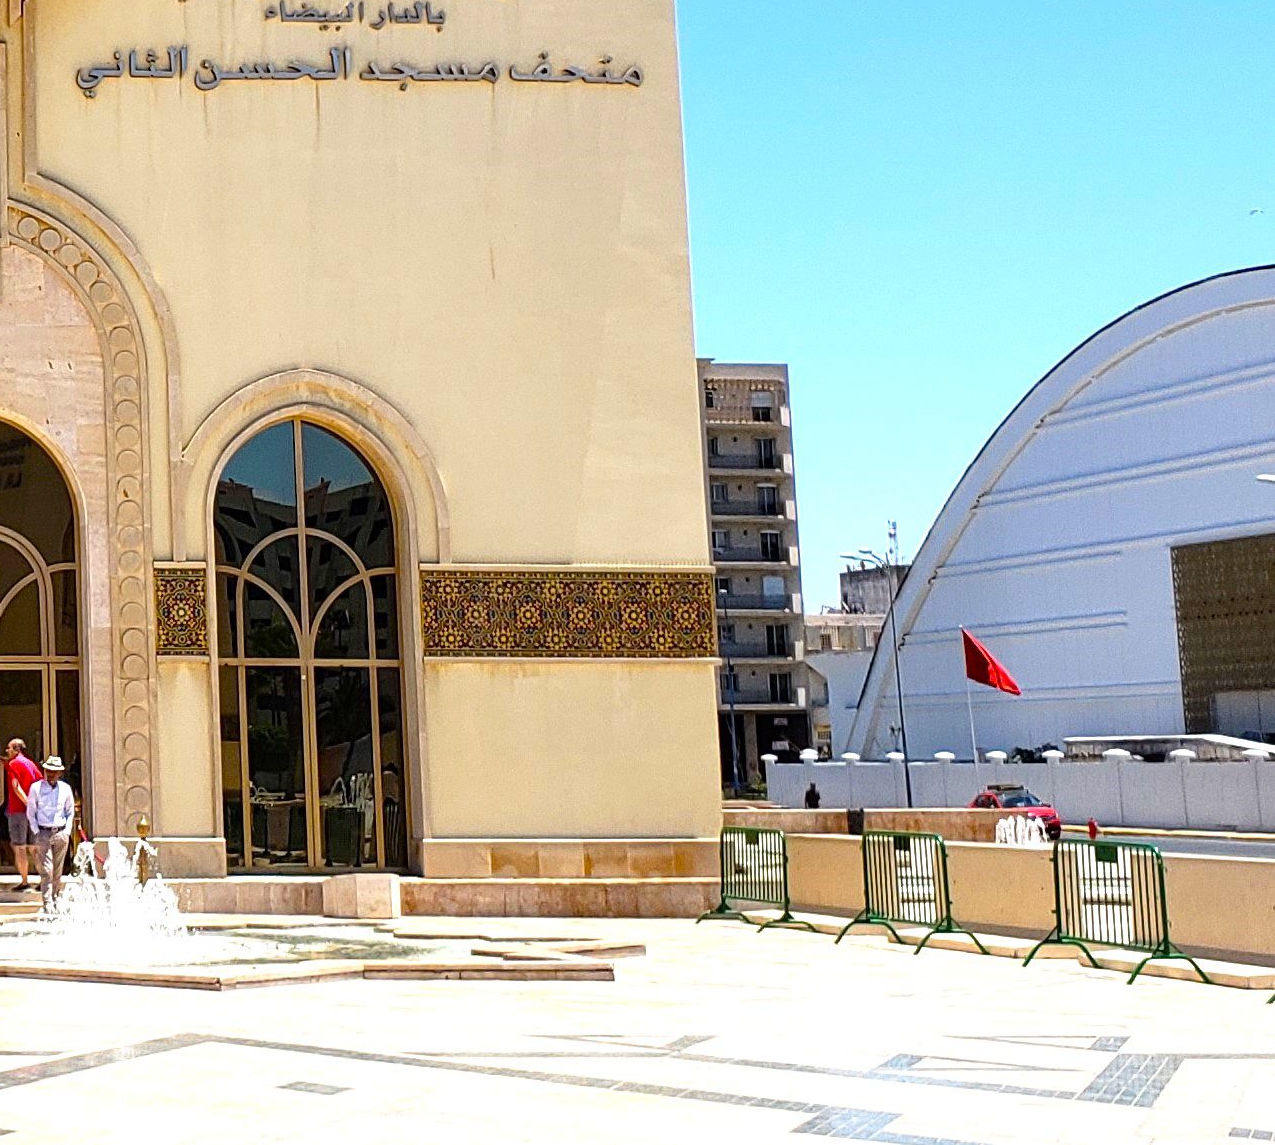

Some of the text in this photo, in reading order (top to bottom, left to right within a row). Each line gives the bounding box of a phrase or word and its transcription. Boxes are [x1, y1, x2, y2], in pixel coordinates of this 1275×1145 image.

[265, 0, 446, 33] بالدار البيضاء
[76, 44, 643, 99] متحف مسجد الحسن الثاني
